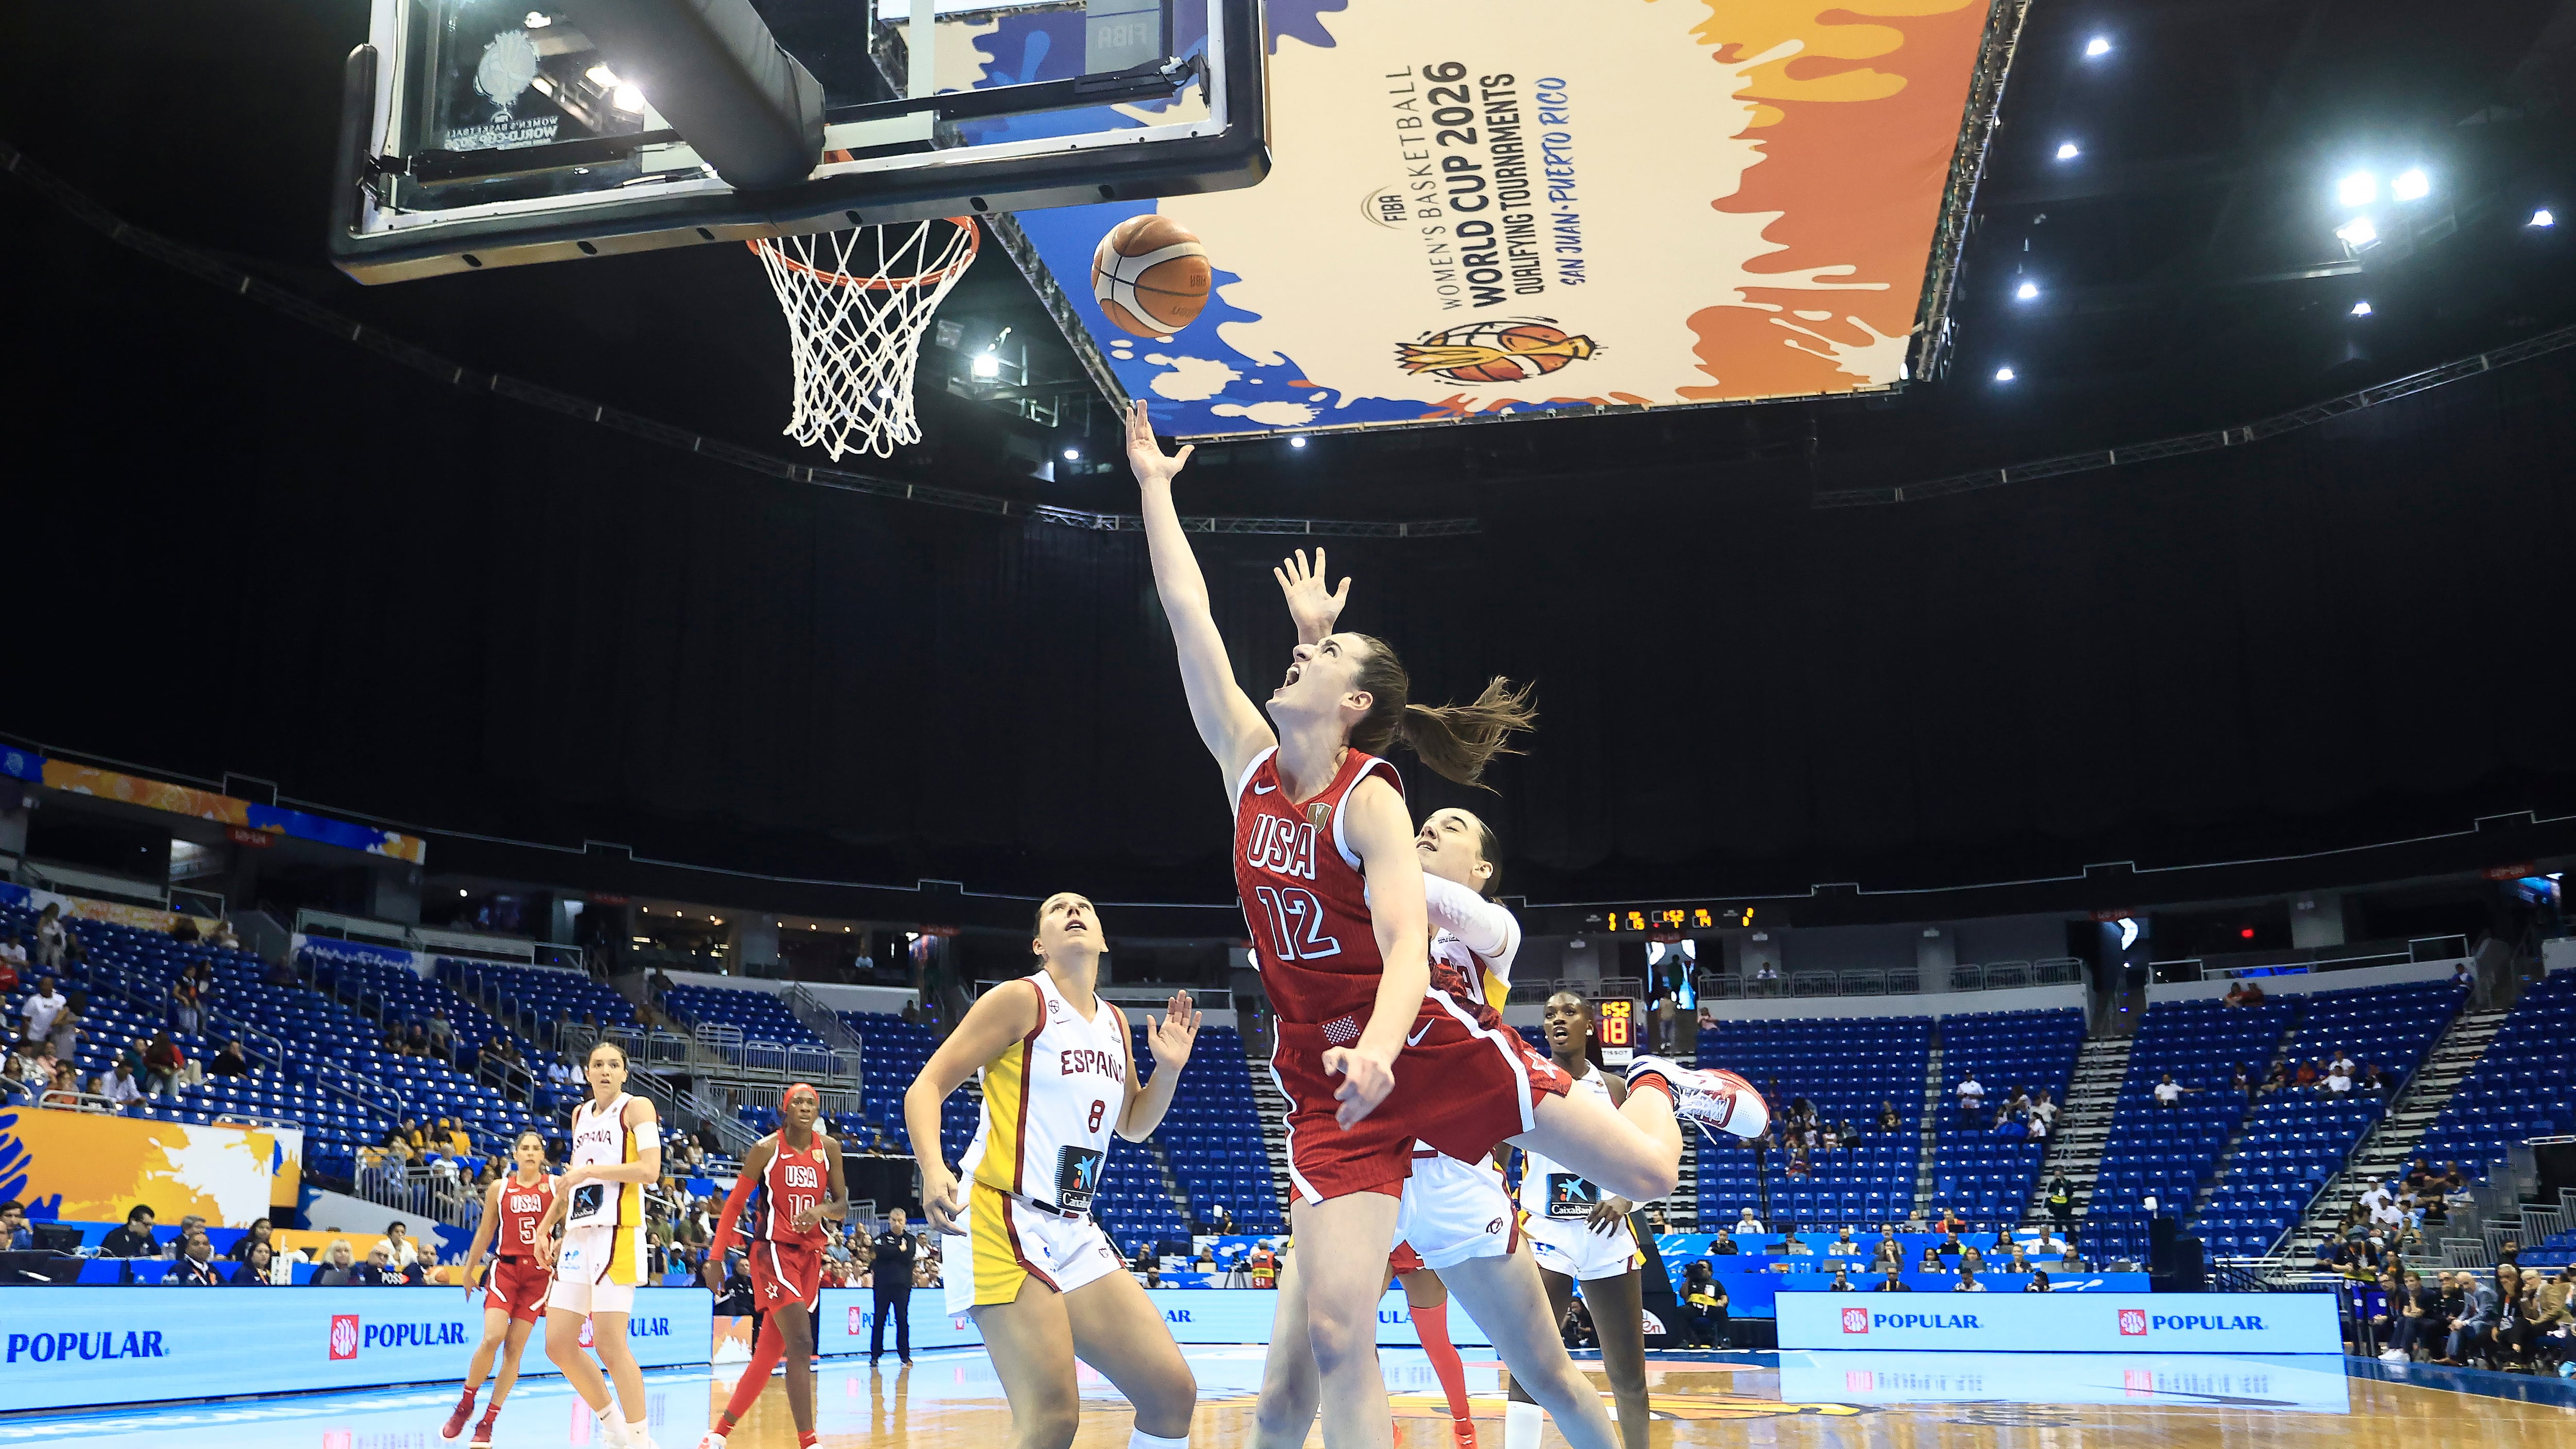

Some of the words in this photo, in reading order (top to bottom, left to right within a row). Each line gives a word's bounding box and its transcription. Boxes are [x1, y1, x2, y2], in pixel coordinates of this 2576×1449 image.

[1422, 61, 1478, 146] 2026
[1534, 77, 1569, 125] RICO
[1385, 65, 1442, 218] BASKETBALL
[1480, 74, 1531, 212] TOURNAMENTS
[1540, 131, 1578, 203] PUERTO
[1442, 156, 1489, 213] CUP
[1378, 194, 1408, 222] FIBA
[1552, 213, 1582, 253] JUAN
[1422, 225, 1462, 310] WOMEN'S
[1455, 220, 1506, 308] WORLD
[1505, 213, 1544, 295] QUALIFYING
[1560, 258, 1586, 286] SAN
[1247, 814, 1315, 880] USA
[1256, 886, 1341, 961] 12
[1663, 910, 1685, 922] 1:52
[1602, 1001, 1631, 1017] 1:52
[1603, 1017, 1627, 1045] 18
[1089, 1100, 1106, 1133] 8
[785, 1165, 818, 1188] USA
[510, 1194, 542, 1213] USA
[518, 1216, 536, 1245] 5
[364, 1322, 465, 1348] POPULAR
[1874, 1314, 1980, 1328] POPULAR
[2152, 1316, 2264, 1329] POPULAR
[7, 1331, 163, 1362] POPULAR
